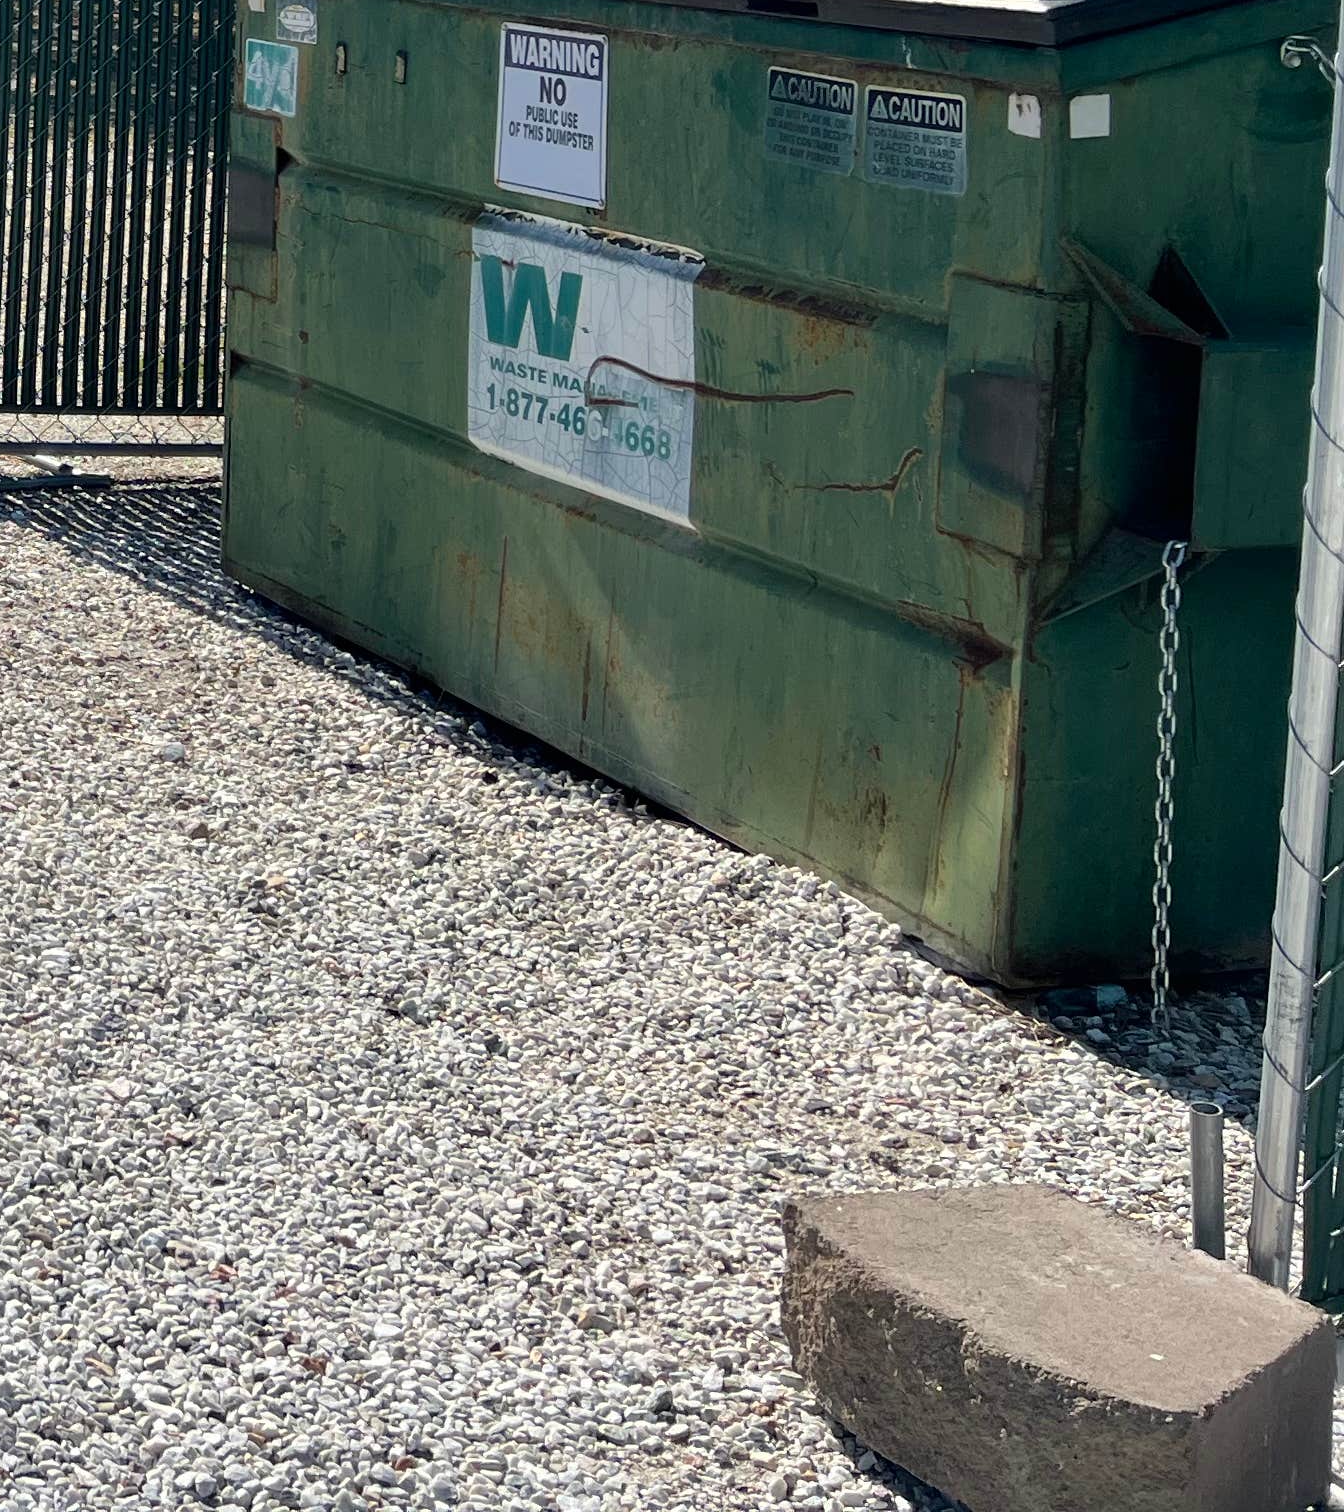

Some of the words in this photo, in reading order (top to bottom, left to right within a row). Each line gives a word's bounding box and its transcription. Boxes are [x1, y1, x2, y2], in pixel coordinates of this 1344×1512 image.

[510, 33, 600, 76] WARNING
[539, 76, 567, 106] NO
[788, 77, 852, 111] CAUTION
[526, 105, 559, 125] PUBLIC
[561, 111, 578, 129] USE
[888, 95, 961, 128] CAUTION
[509, 121, 521, 137] OF
[523, 123, 544, 141] THIS
[546, 127, 594, 151] DUMPSTER
[867, 126, 920, 142] CONTAINER
[923, 134, 949, 146] MUST
[950, 137, 963, 149] BE
[873, 140, 910, 154] PLACED
[913, 145, 927, 157] ON
[929, 148, 956, 161] HARD
[873, 152, 901, 166] LEVEL
[489, 356, 547, 384] WASTE
